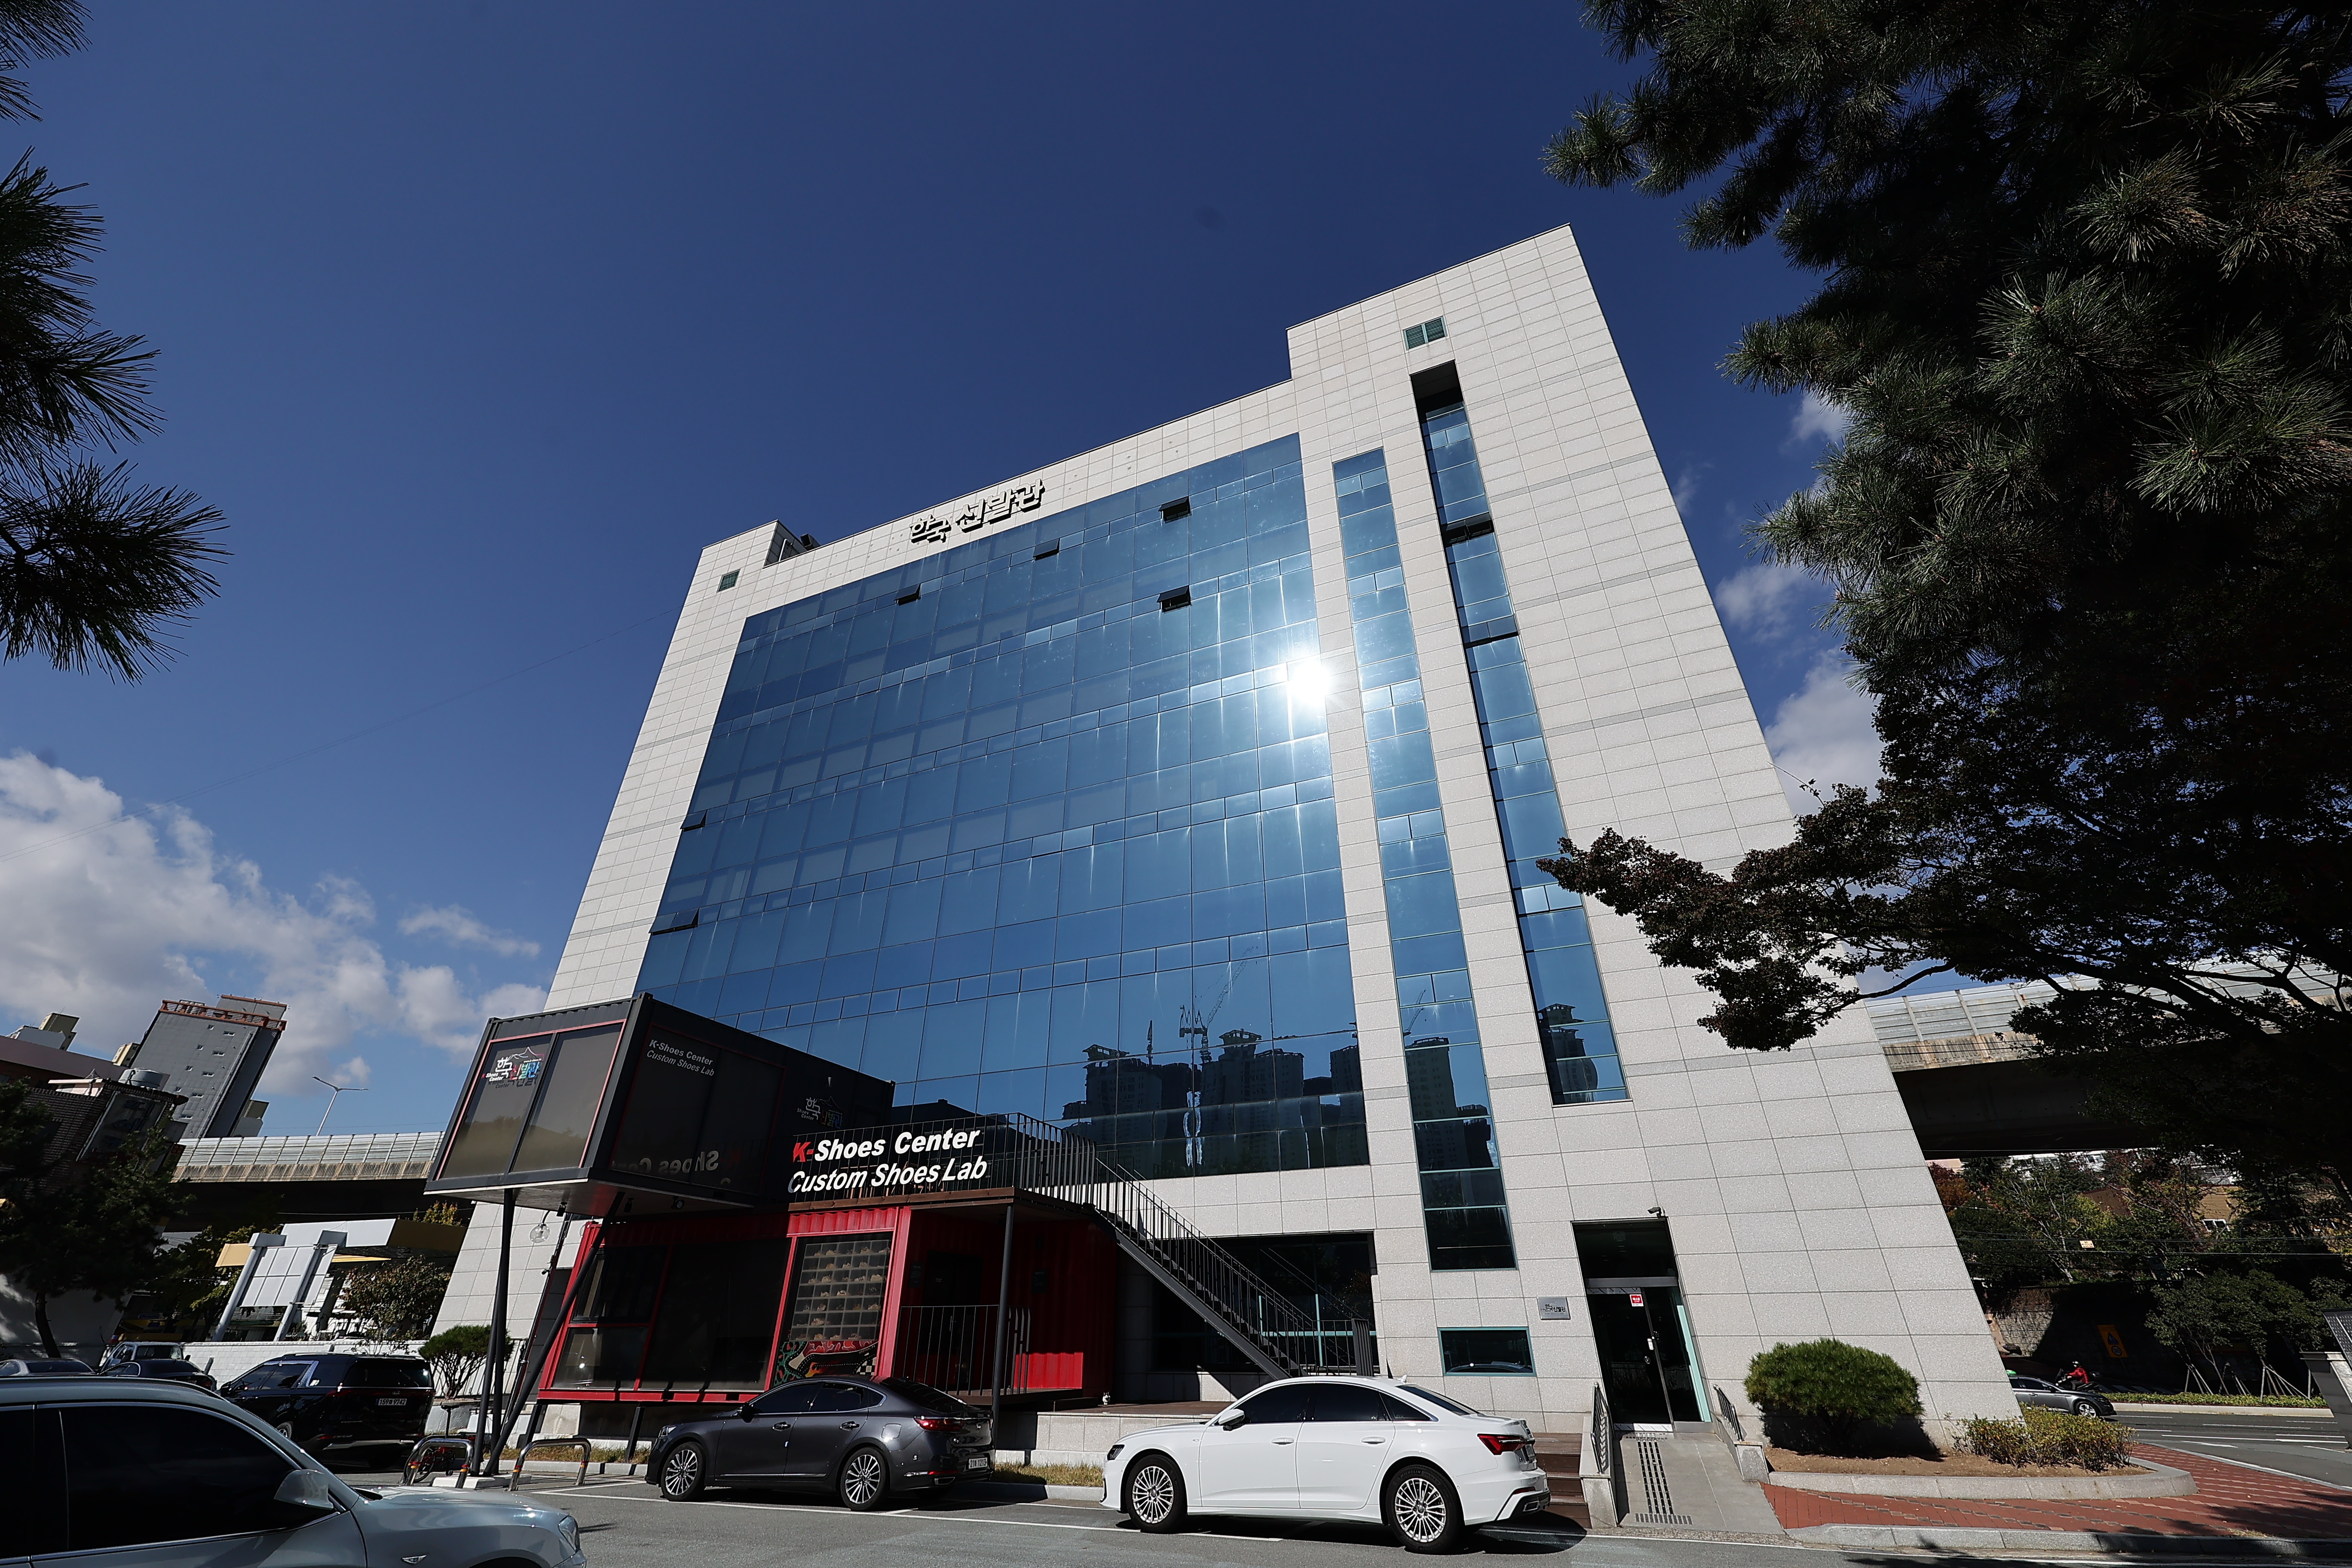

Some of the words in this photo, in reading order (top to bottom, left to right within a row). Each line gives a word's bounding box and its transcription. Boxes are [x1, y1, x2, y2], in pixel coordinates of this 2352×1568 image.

[647, 1050, 676, 1065] Custom
[677, 1059, 700, 1072] Shoes
[701, 1066, 714, 1076] Lab
[649, 1039, 684, 1057] K-Shoes
[686, 1051, 714, 1066] Center
[793, 1139, 886, 1162] K-Shoes
[894, 1128, 981, 1154] Center
[788, 1168, 868, 1193] Custom
[871, 1163, 941, 1187] Shoes
[942, 1156, 988, 1181] Lab
